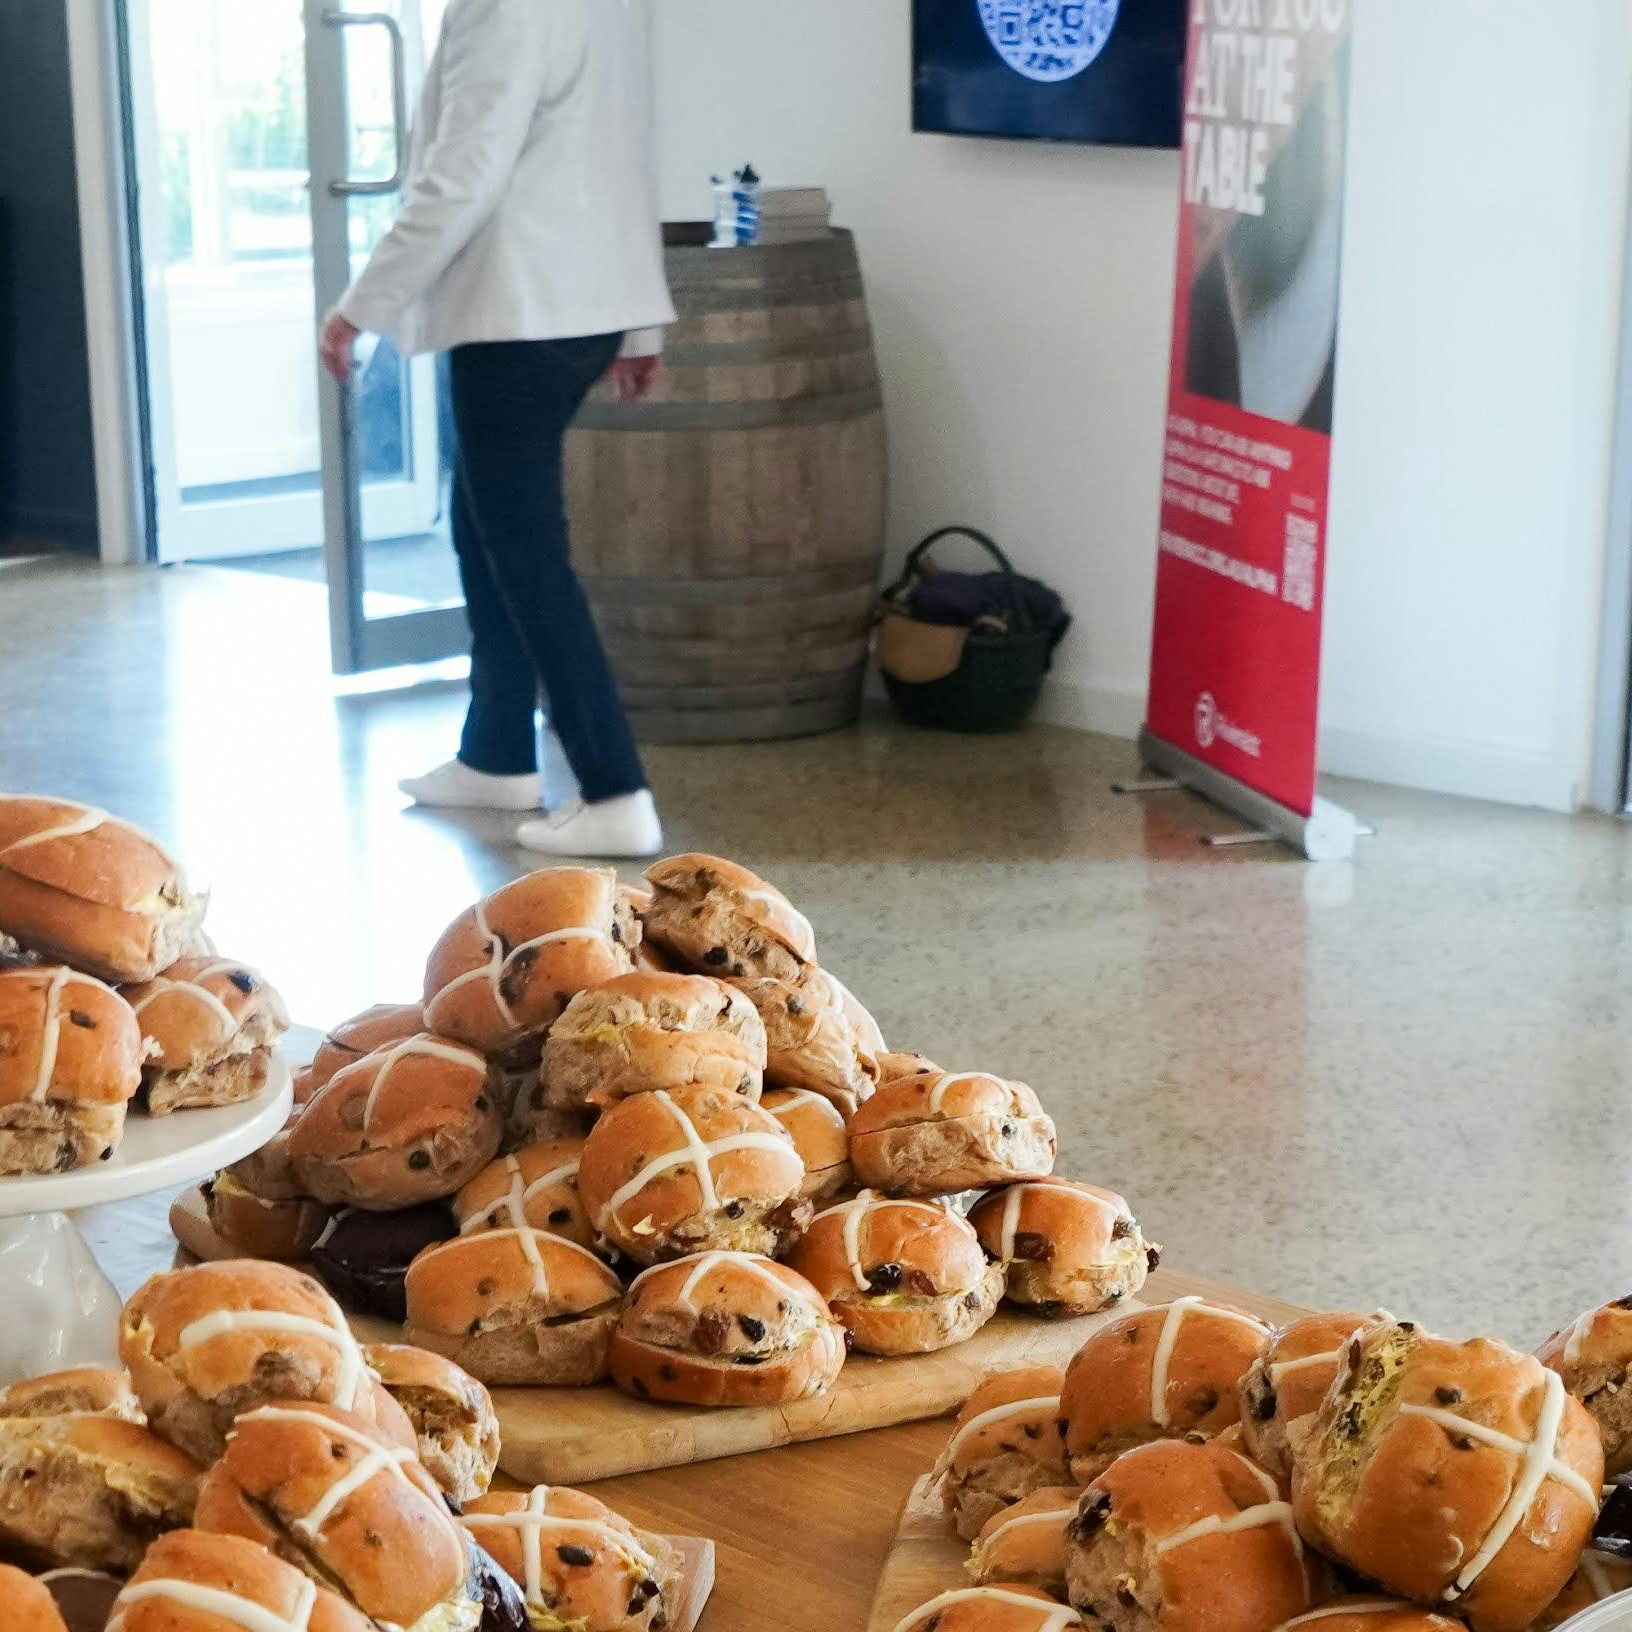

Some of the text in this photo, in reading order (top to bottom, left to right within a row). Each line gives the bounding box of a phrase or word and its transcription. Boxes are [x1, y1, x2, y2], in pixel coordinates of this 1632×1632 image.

[1185, 33, 1296, 124] AT THE
[1184, 122, 1266, 215] TABLE
